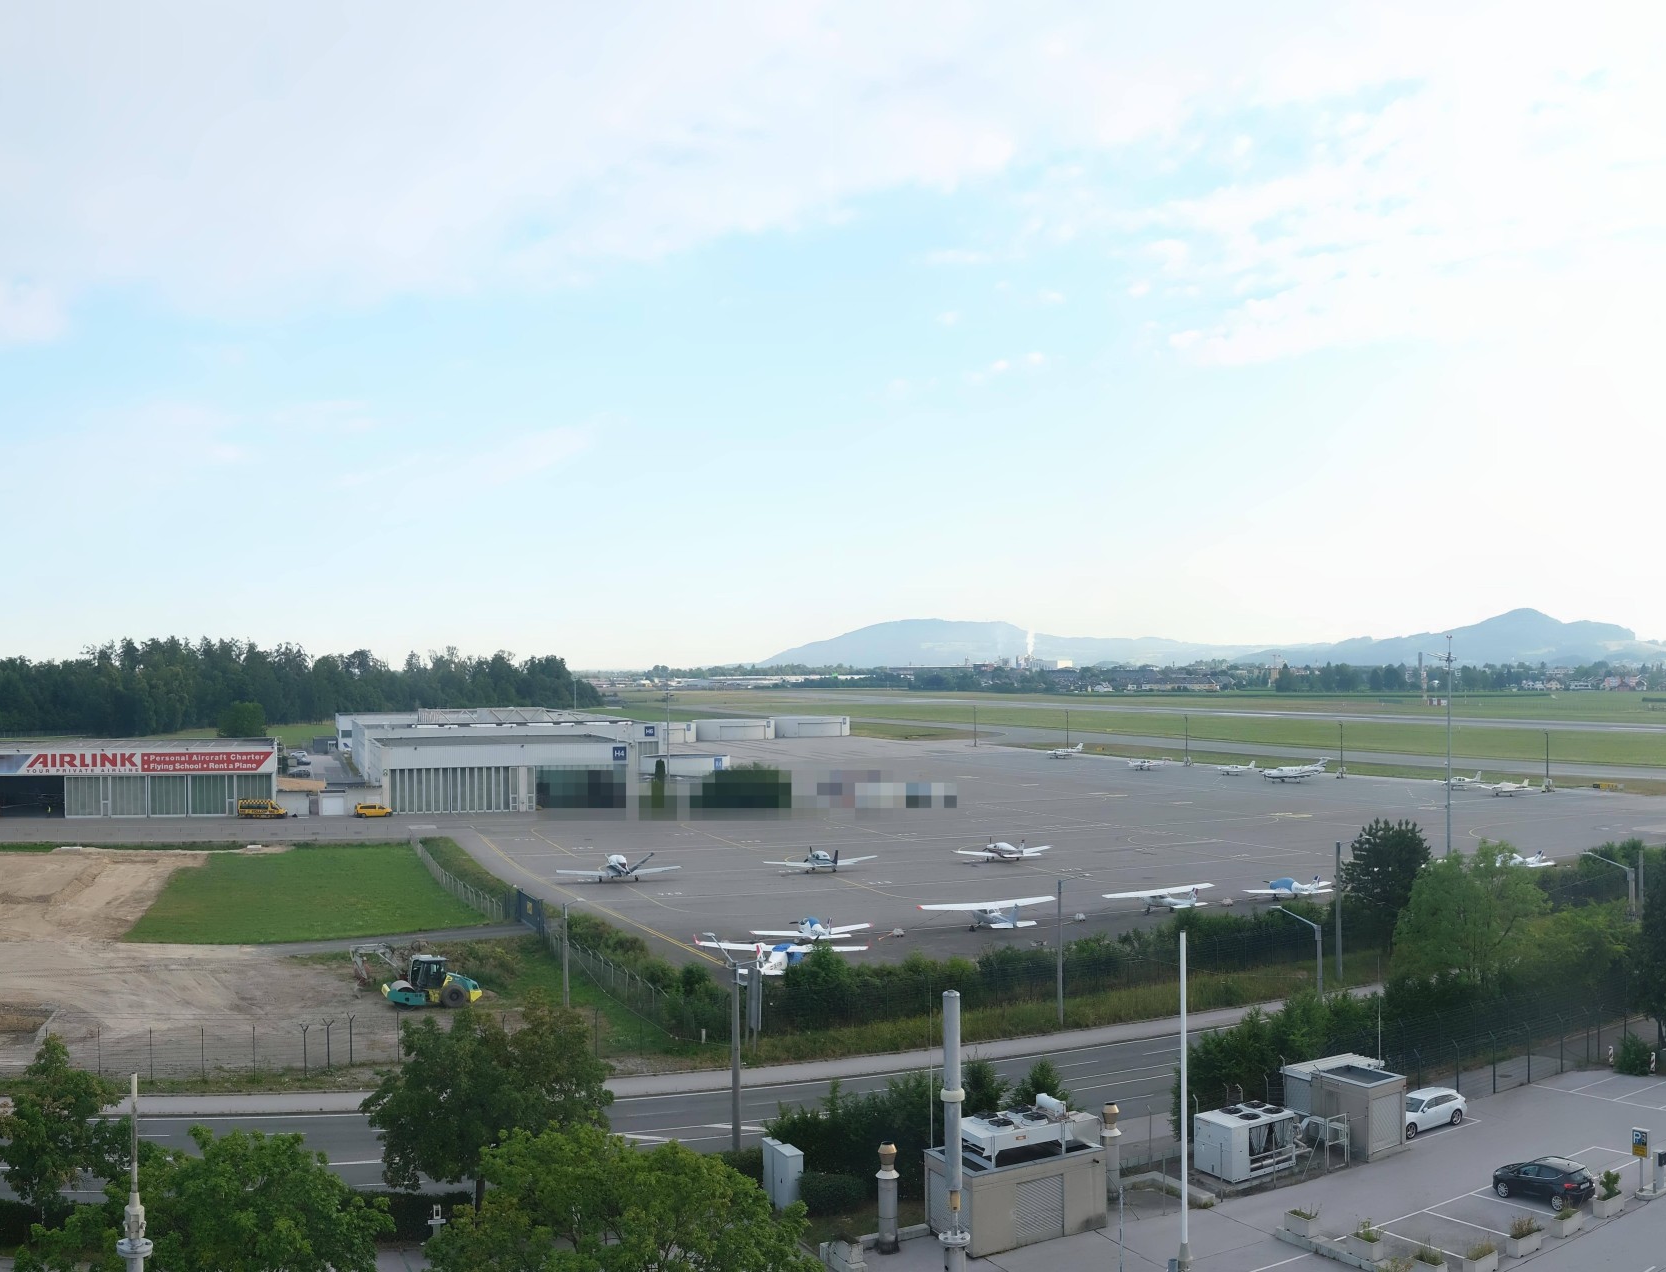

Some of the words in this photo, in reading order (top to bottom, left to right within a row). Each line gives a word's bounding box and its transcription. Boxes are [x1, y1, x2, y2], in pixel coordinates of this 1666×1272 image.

[26, 752, 139, 768] AIRLINK
[149, 754, 189, 762] Personal
[230, 753, 264, 761] Charter
[150, 763, 173, 771] Flying
[175, 762, 202, 770] School
[1633, 1131, 1641, 1144] P
